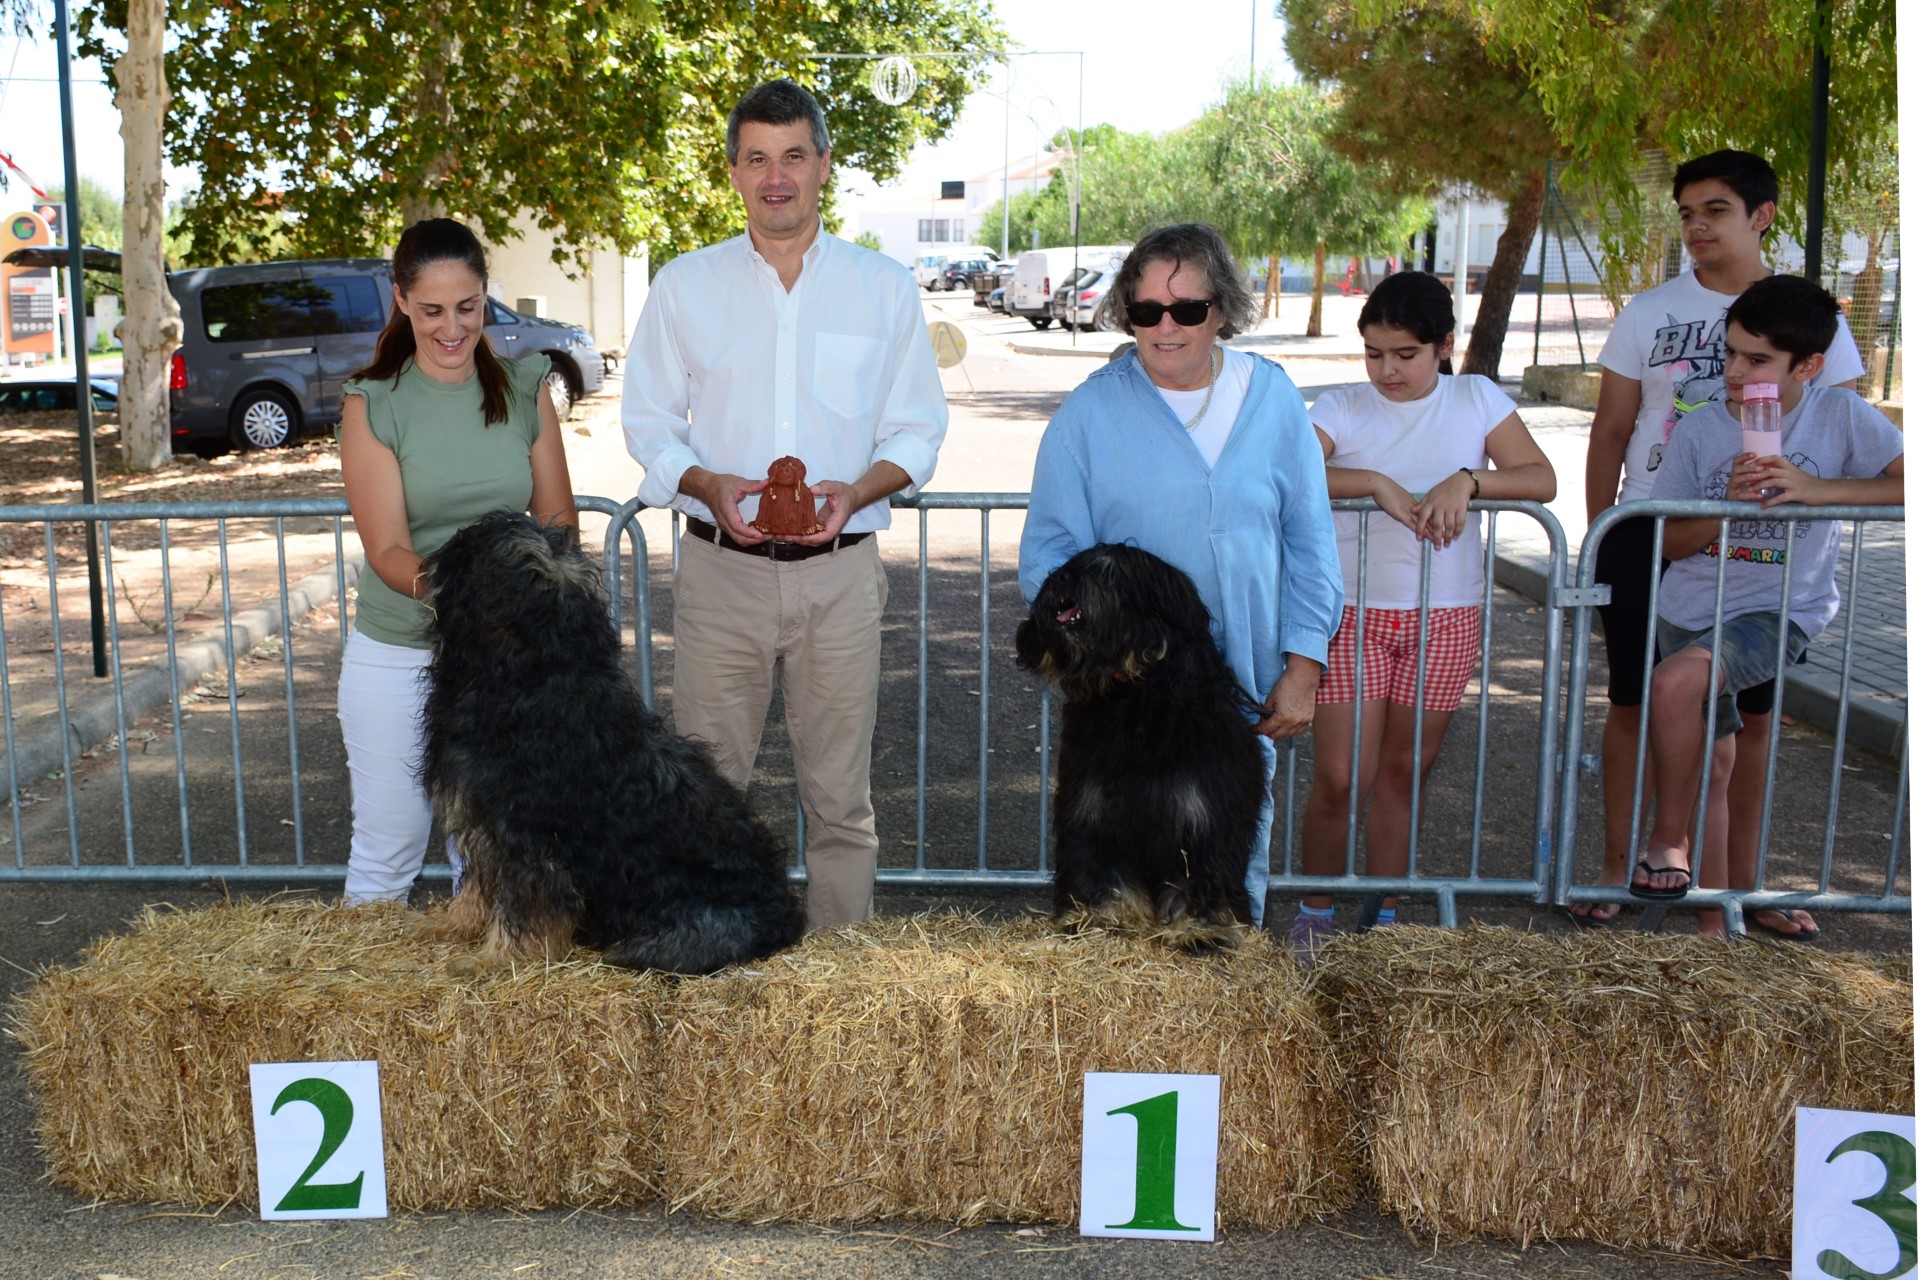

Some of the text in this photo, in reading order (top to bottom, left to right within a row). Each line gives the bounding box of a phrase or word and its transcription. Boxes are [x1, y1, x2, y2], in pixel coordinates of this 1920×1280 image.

[270, 1077, 365, 1212] 2
[1104, 1090, 1202, 1232] 1
[1816, 1130, 1918, 1280] 3
